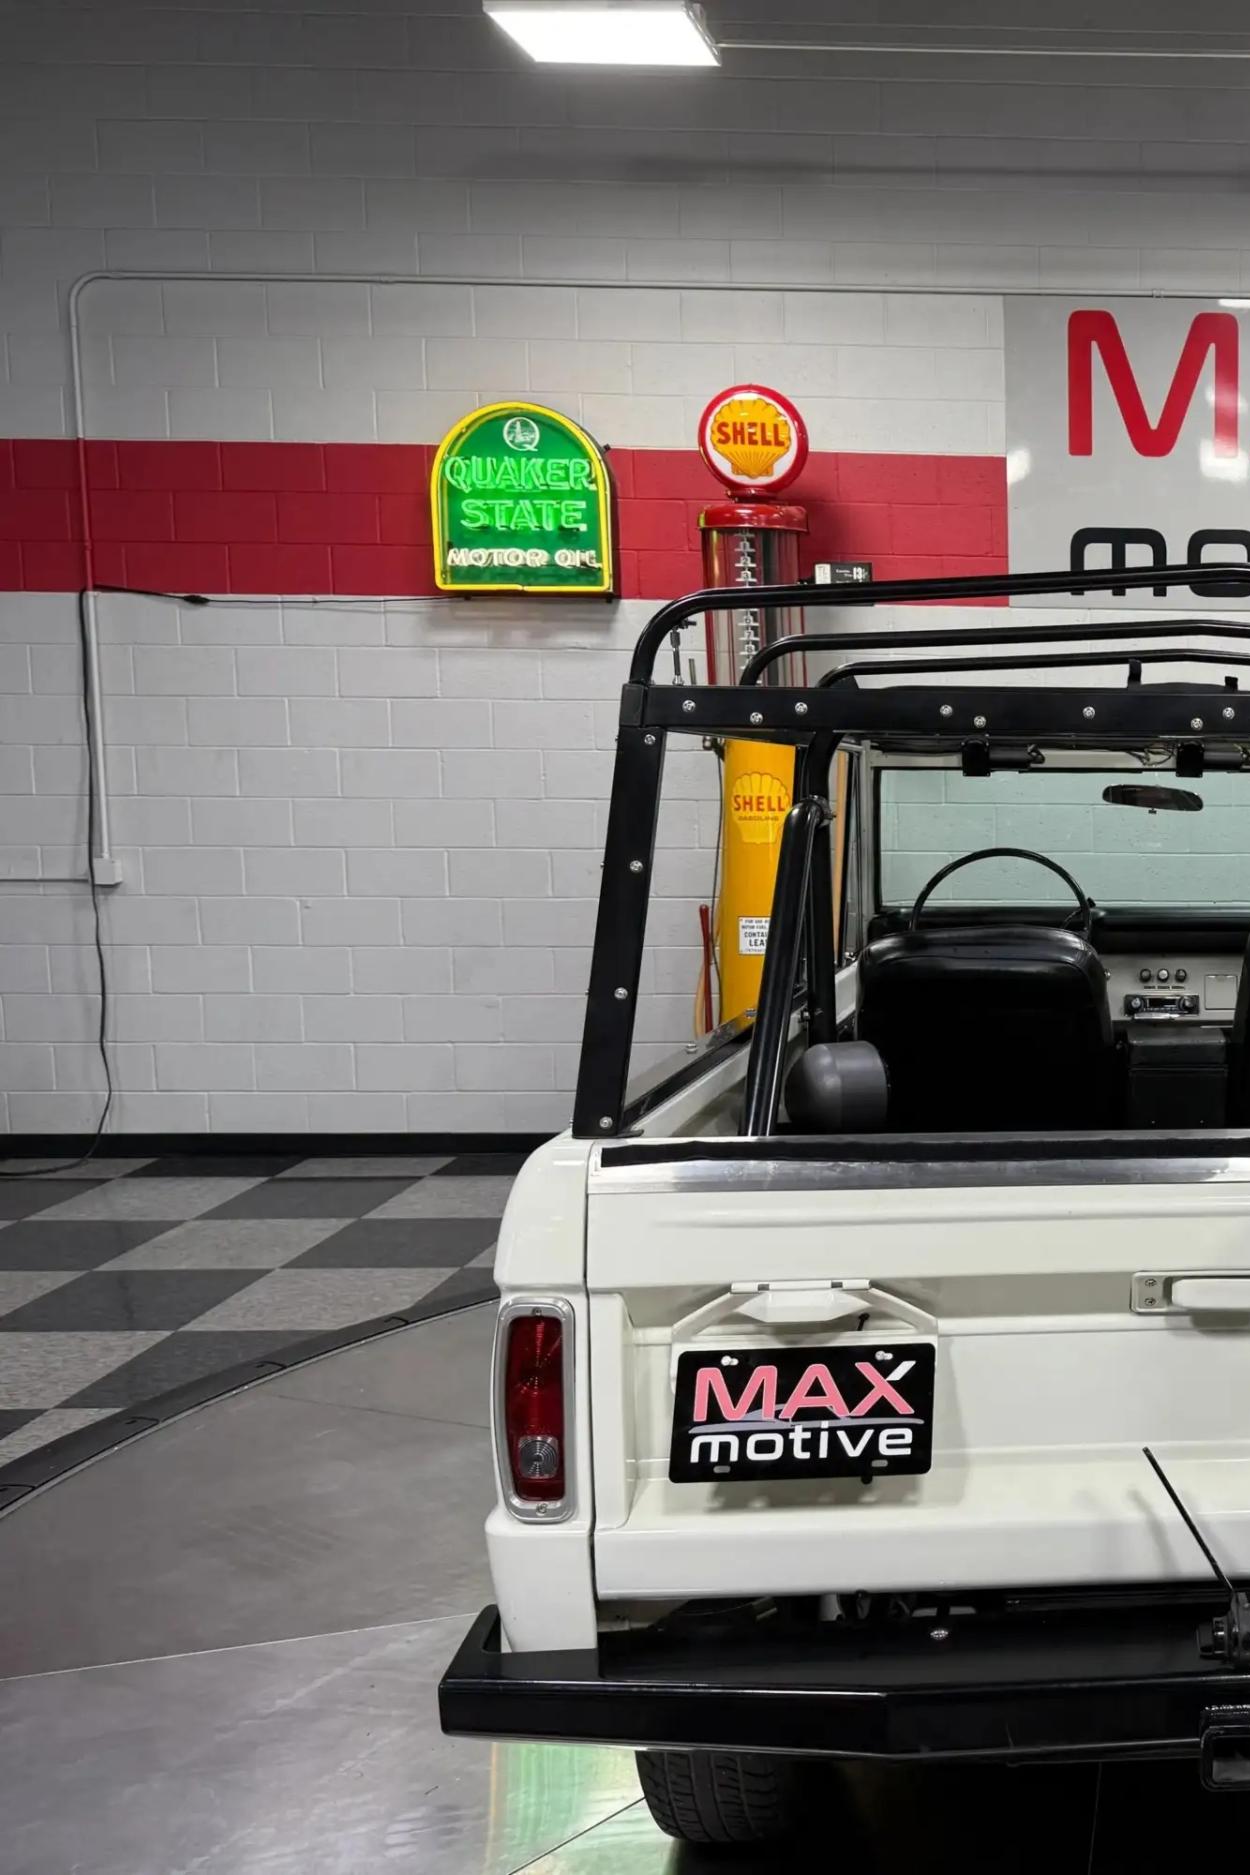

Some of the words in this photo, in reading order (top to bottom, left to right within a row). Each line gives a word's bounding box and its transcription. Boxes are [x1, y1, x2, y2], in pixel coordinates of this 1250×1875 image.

[716, 421, 785, 447] SHELL
[445, 456, 597, 493] QUAKER
[460, 499, 587, 531] STATE
[447, 548, 550, 567] MOTOR
[554, 549, 603, 568] OIL
[733, 794, 786, 812] SHELL
[693, 1360, 916, 1422] MAX
[690, 1421, 913, 1463] motive
